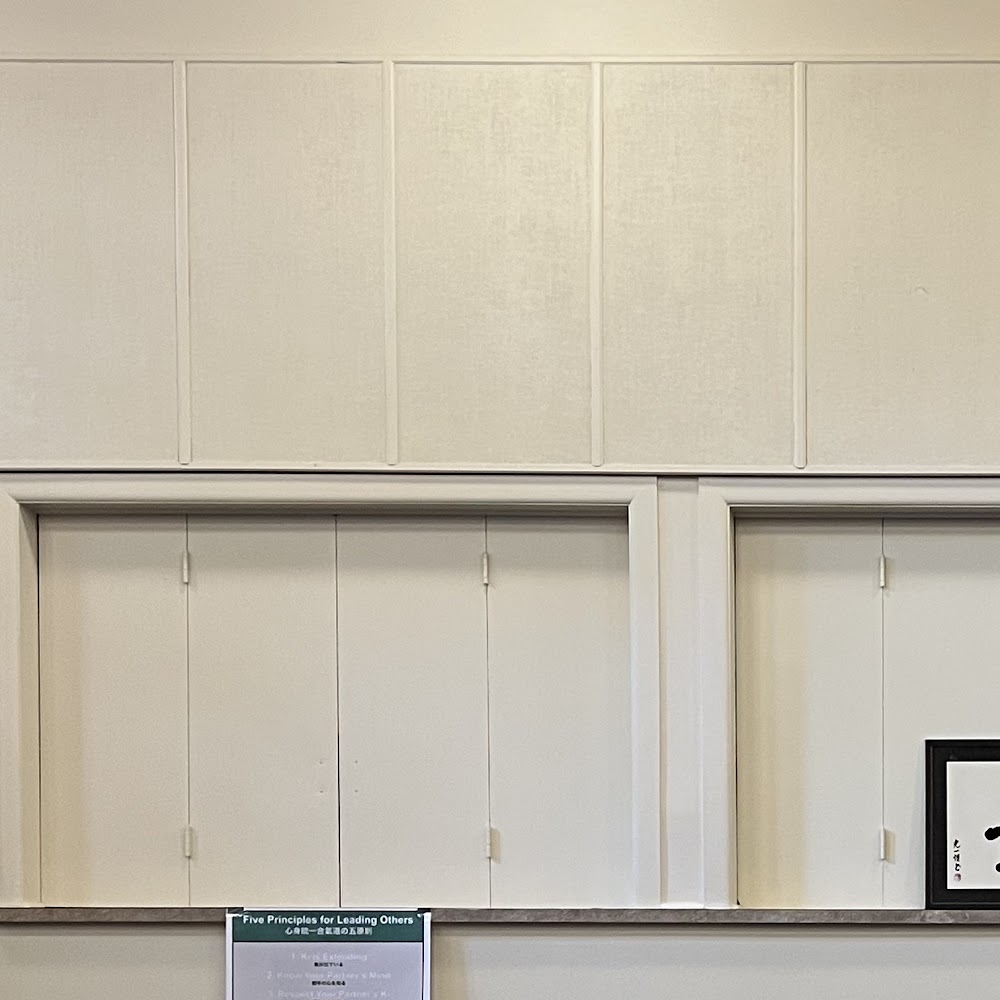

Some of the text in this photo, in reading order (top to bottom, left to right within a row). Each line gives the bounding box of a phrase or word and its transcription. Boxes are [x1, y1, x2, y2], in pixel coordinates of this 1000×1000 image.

[243, 915, 414, 926] Five Principles for Leading Others
